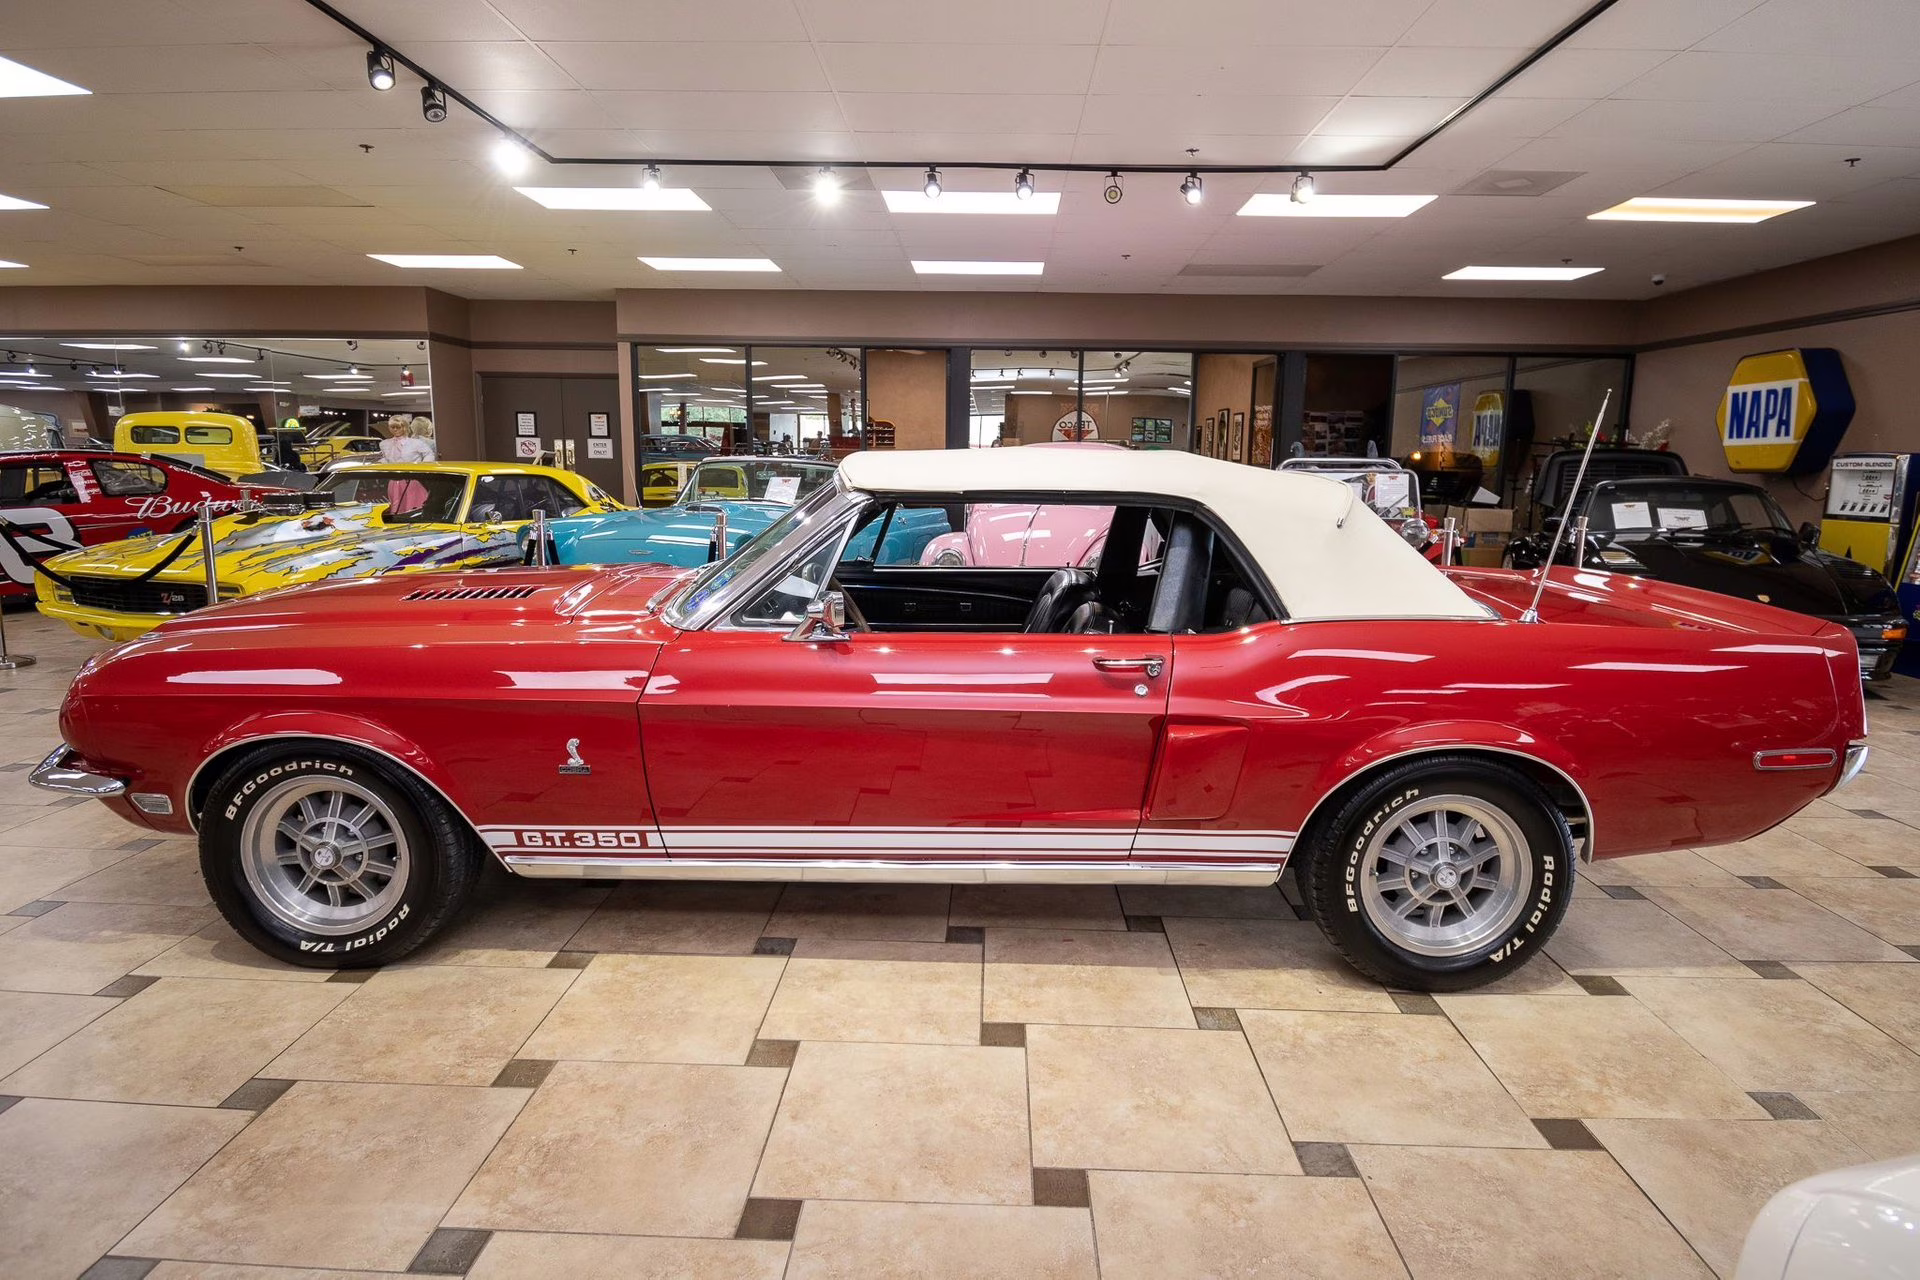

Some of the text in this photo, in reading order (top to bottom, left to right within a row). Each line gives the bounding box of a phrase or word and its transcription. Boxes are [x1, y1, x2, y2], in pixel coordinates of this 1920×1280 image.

[1728, 387, 1792, 439] NAPA
[225, 760, 353, 821] BFGoodrich
[1345, 788, 1420, 913] BFGoodrich
[300, 903, 410, 953] Radial T/A
[1489, 855, 1555, 963] Radial T/A
